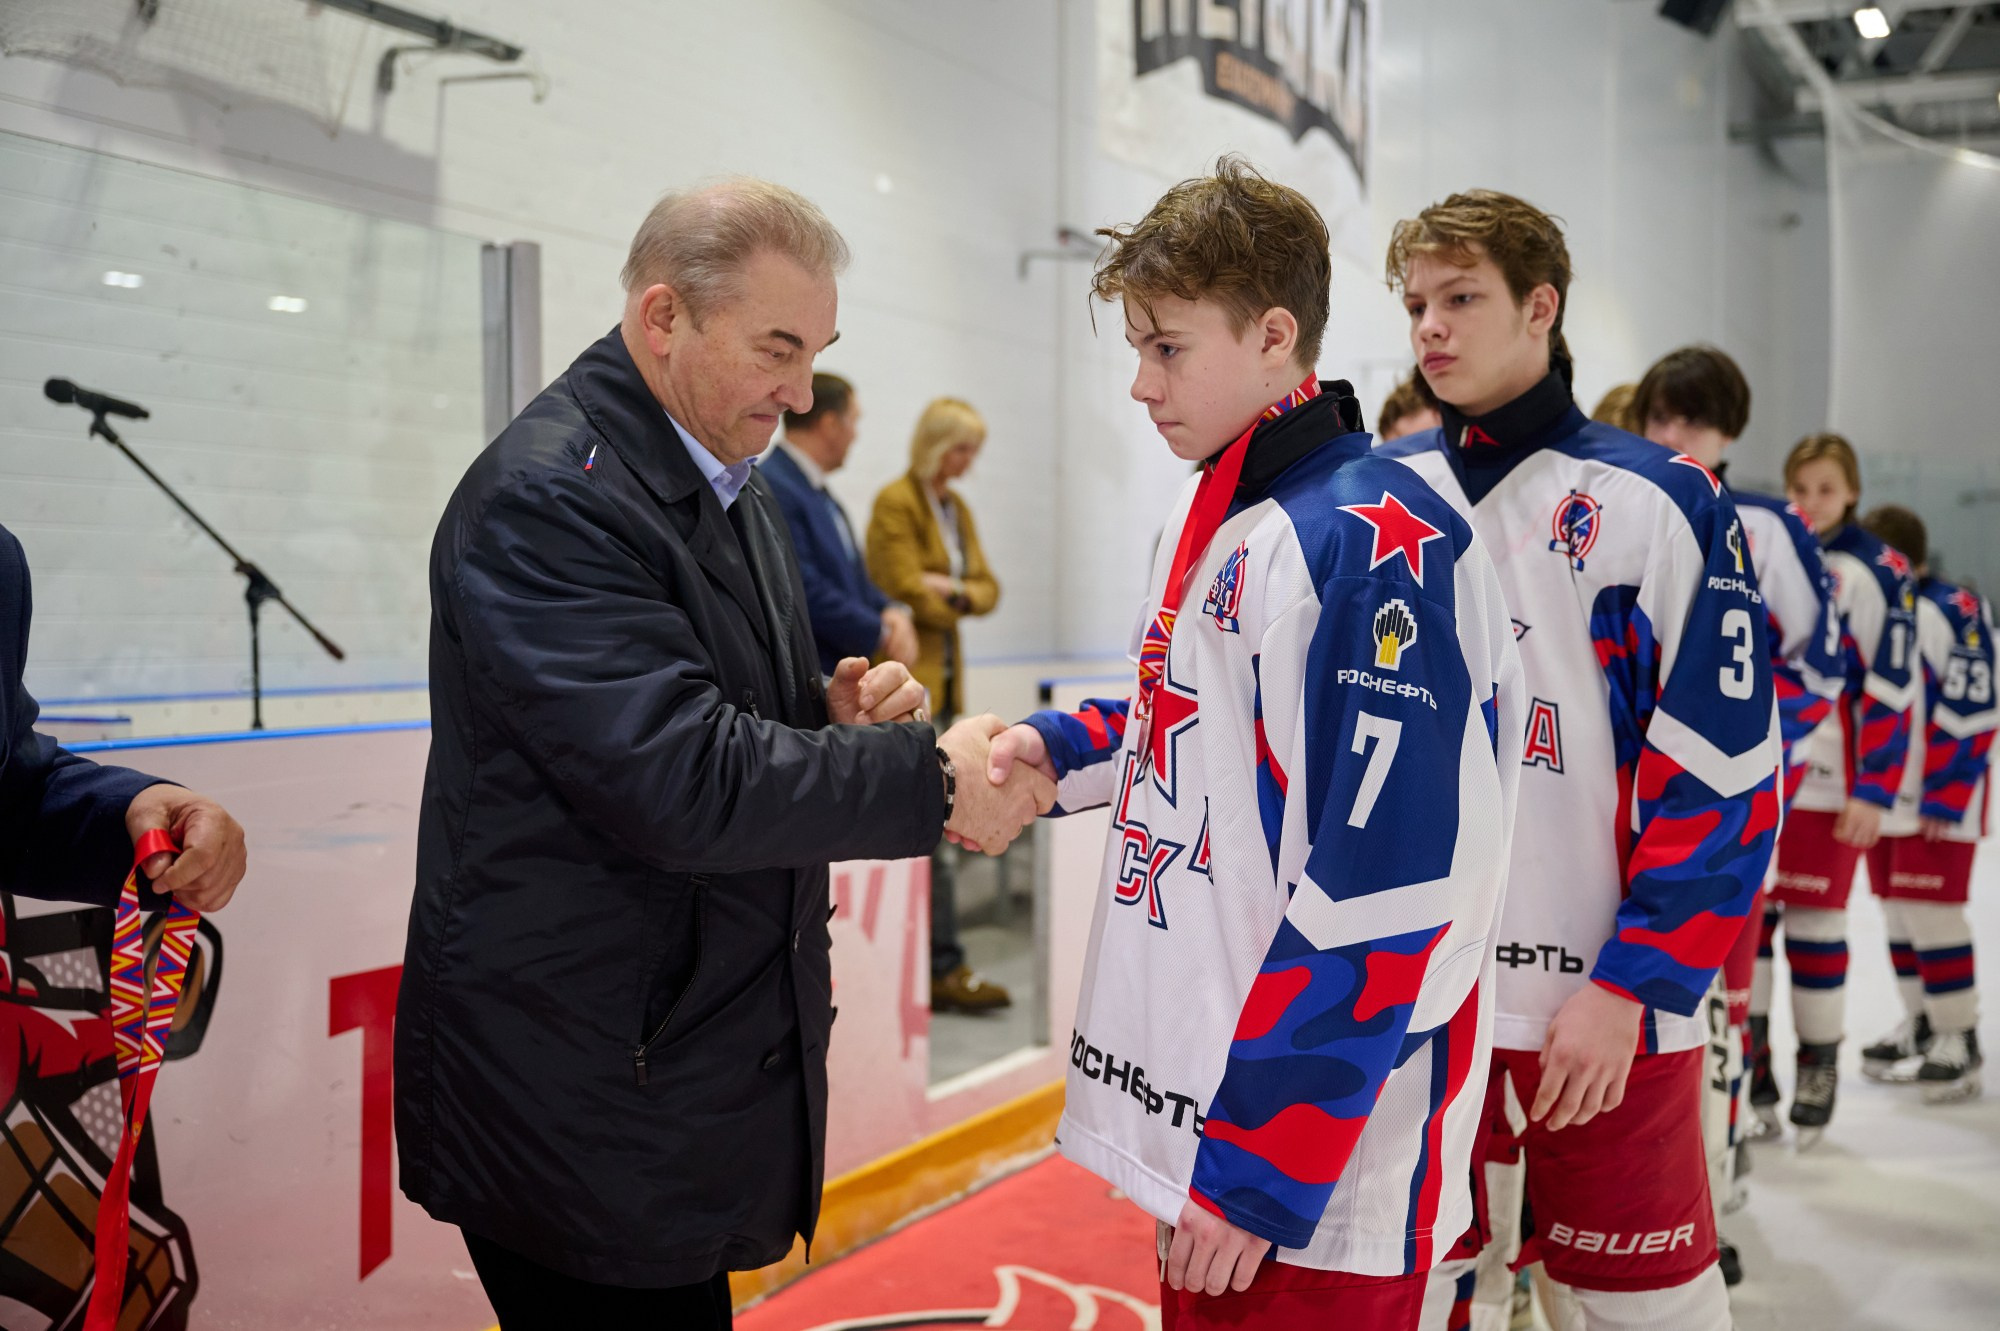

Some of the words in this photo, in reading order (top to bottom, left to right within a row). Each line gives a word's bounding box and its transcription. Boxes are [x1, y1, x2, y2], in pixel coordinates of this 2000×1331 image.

[1719, 608, 1754, 700] 3
[1942, 656, 1991, 704] 53
[1337, 669, 1438, 711] РОСНЕФТЬ
[1347, 710, 1403, 829] 7
